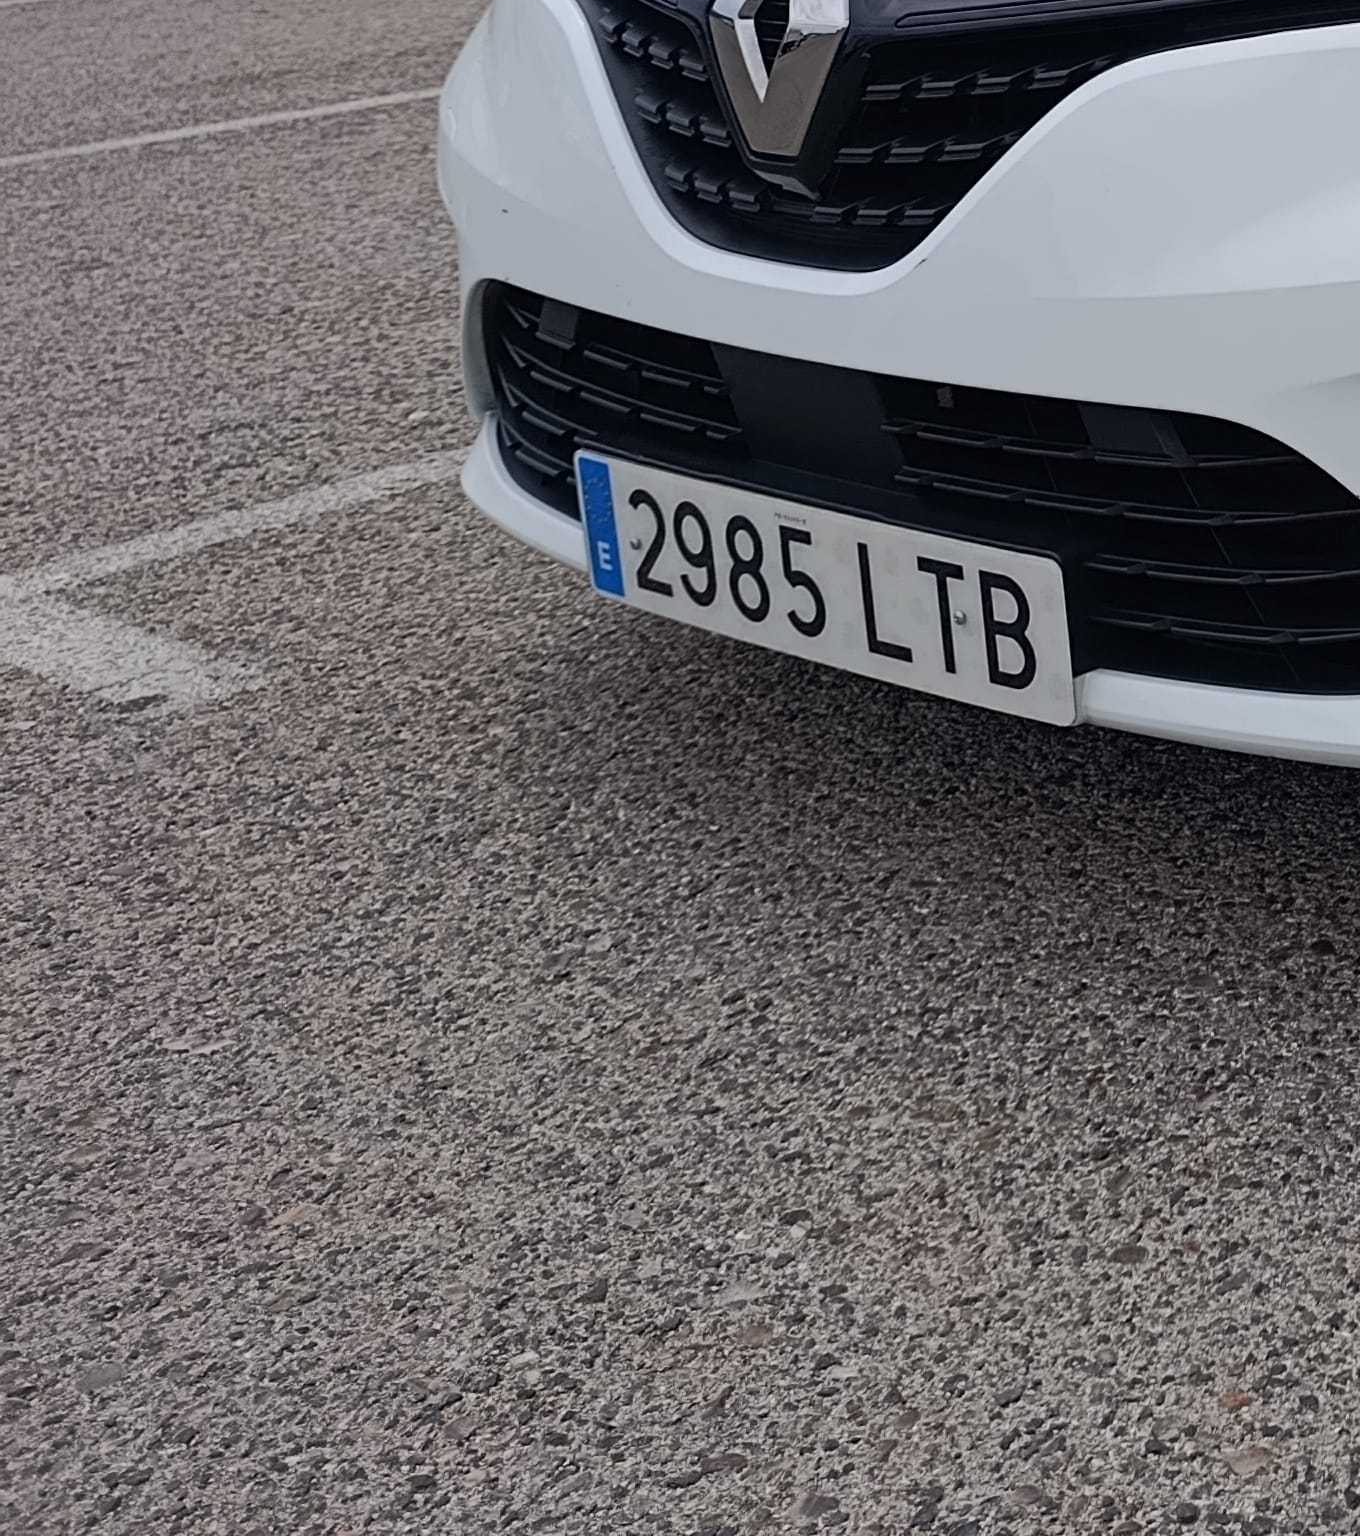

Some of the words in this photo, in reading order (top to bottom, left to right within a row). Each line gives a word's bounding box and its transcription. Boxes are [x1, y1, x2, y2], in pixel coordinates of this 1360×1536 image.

[597, 540, 613, 571] E
[629, 488, 827, 638] 2985
[857, 542, 1037, 690] LTB
